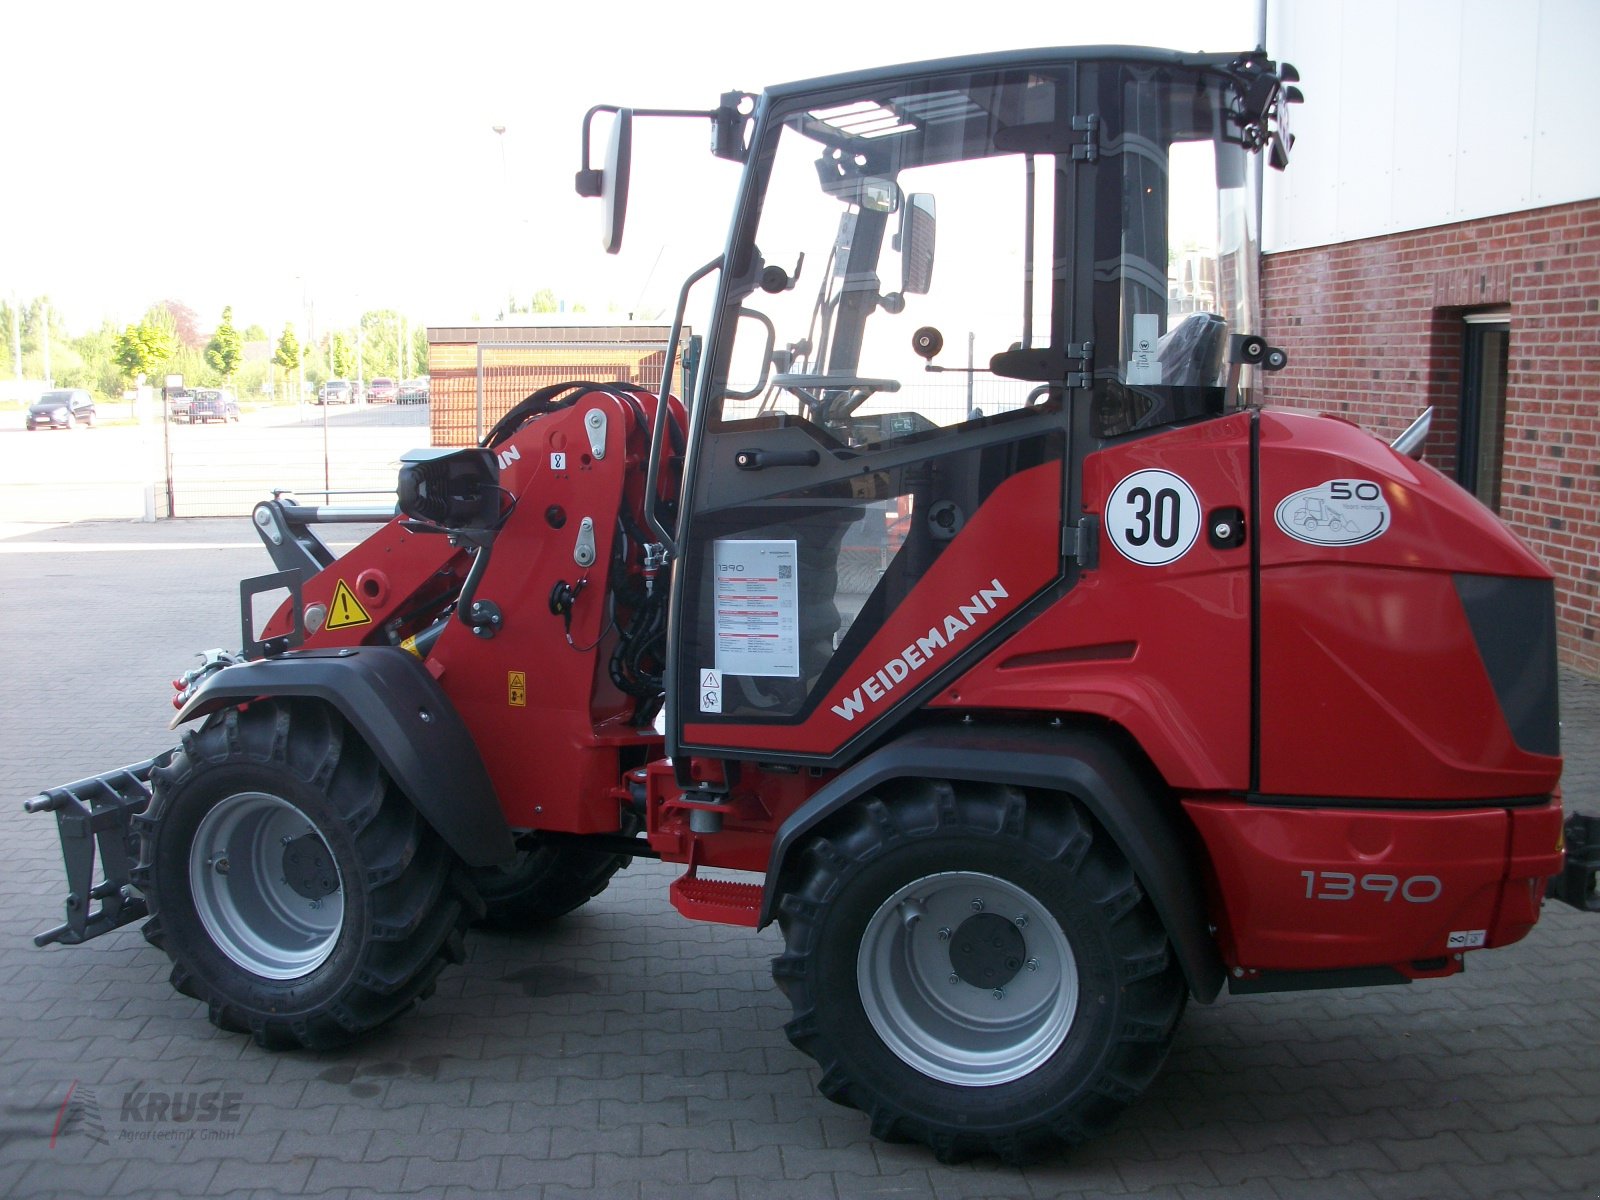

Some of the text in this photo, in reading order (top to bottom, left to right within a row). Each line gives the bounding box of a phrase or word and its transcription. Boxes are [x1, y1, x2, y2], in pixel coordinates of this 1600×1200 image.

[1331, 482, 1380, 501] 50
[1125, 487, 1181, 548] 30
[718, 564, 745, 572] 1390
[831, 578, 1009, 721] WEIDEMANN
[1300, 870, 1442, 904] 1390
